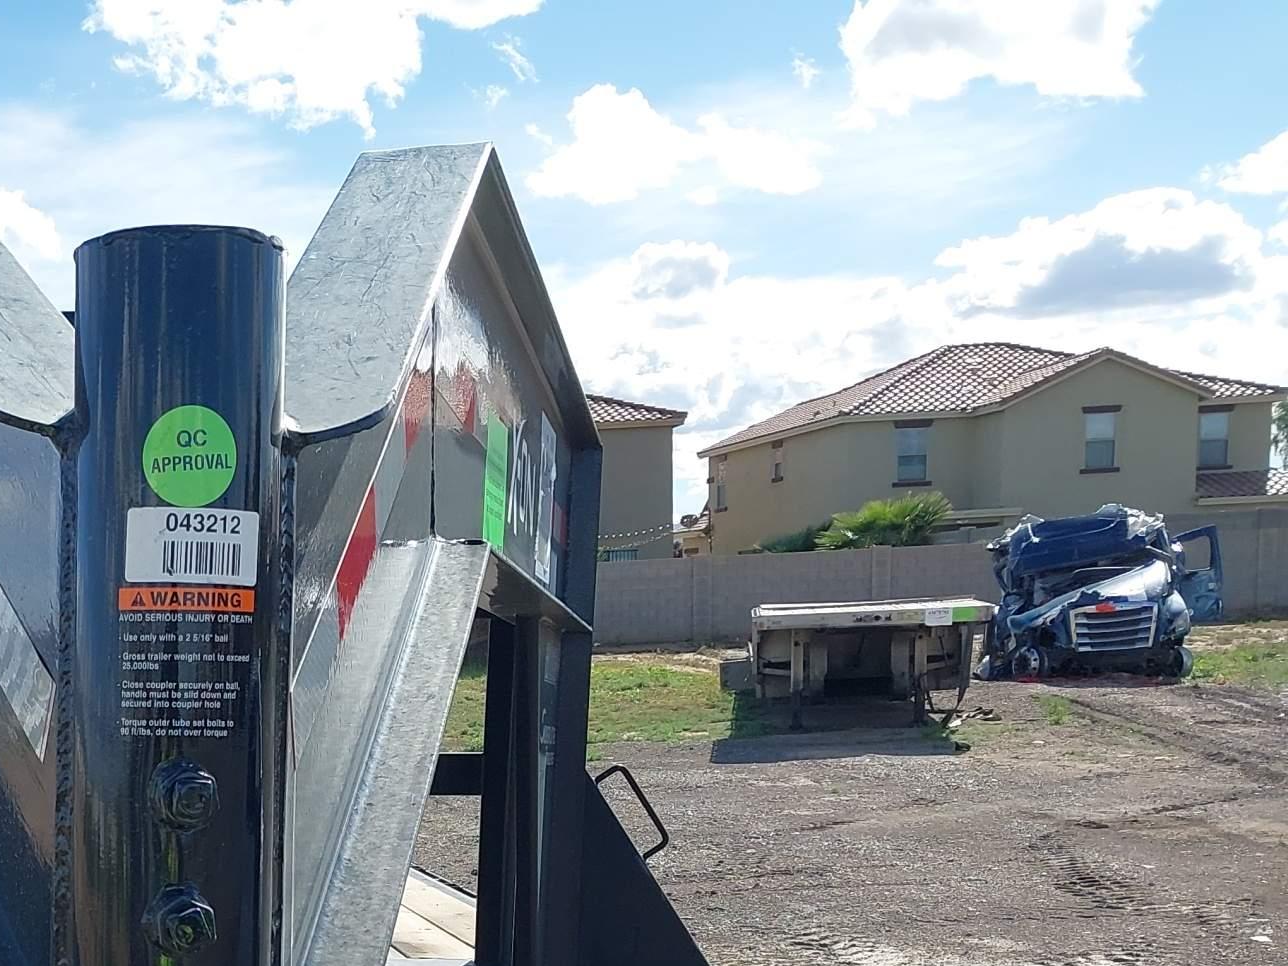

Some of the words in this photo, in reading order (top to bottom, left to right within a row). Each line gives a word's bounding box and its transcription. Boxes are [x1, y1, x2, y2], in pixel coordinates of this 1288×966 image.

[176, 429, 208, 448] QC
[151, 453, 233, 474] APPROVAL
[165, 512, 241, 535] 043212
[150, 591, 242, 608] WARNING
[119, 613, 143, 622] AVOID
[145, 613, 183, 622] SERIOUS
[185, 613, 216, 623] INJURY
[217, 614, 229, 623] OR
[231, 615, 253, 624] DEATH
[123, 633, 138, 642] Use
[140, 633, 157, 644] only
[158, 633, 176, 642] with
[186, 634, 190, 642] 2
[215, 634, 228, 643] ball
[123, 652, 146, 661] Gross
[147, 652, 172, 661] trailer
[173, 652, 201, 662] weight
[203, 653, 215, 661] not
[217, 653, 225, 661] to
[226, 653, 250, 662] exceed
[122, 680, 144, 689] Close
[146, 681, 177, 691] coupler
[179, 681, 213, 692] securely
[226, 682, 241, 691] ball,
[121, 690, 147, 698] handle
[149, 690, 170, 698] must
[172, 690, 182, 698] be
[183, 690, 199, 699] slid
[200, 690, 222, 699] down
[223, 691, 237, 700] and
[121, 700, 152, 708] secured
[154, 700, 170, 708] into
[171, 700, 203, 709] coupler
[204, 700, 221, 709] hole
[121, 718, 147, 728] Torque
[148, 719, 170, 727] outer
[172, 718, 191, 727] tube
[192, 719, 205, 727] set
[206, 719, 226, 728] bolts
[226, 720, 234, 728] to
[120, 727, 130, 736] 90
[155, 727, 167, 736] do
[168, 728, 182, 736] not
[183, 729, 202, 737] over
[203, 729, 228, 739] torque
